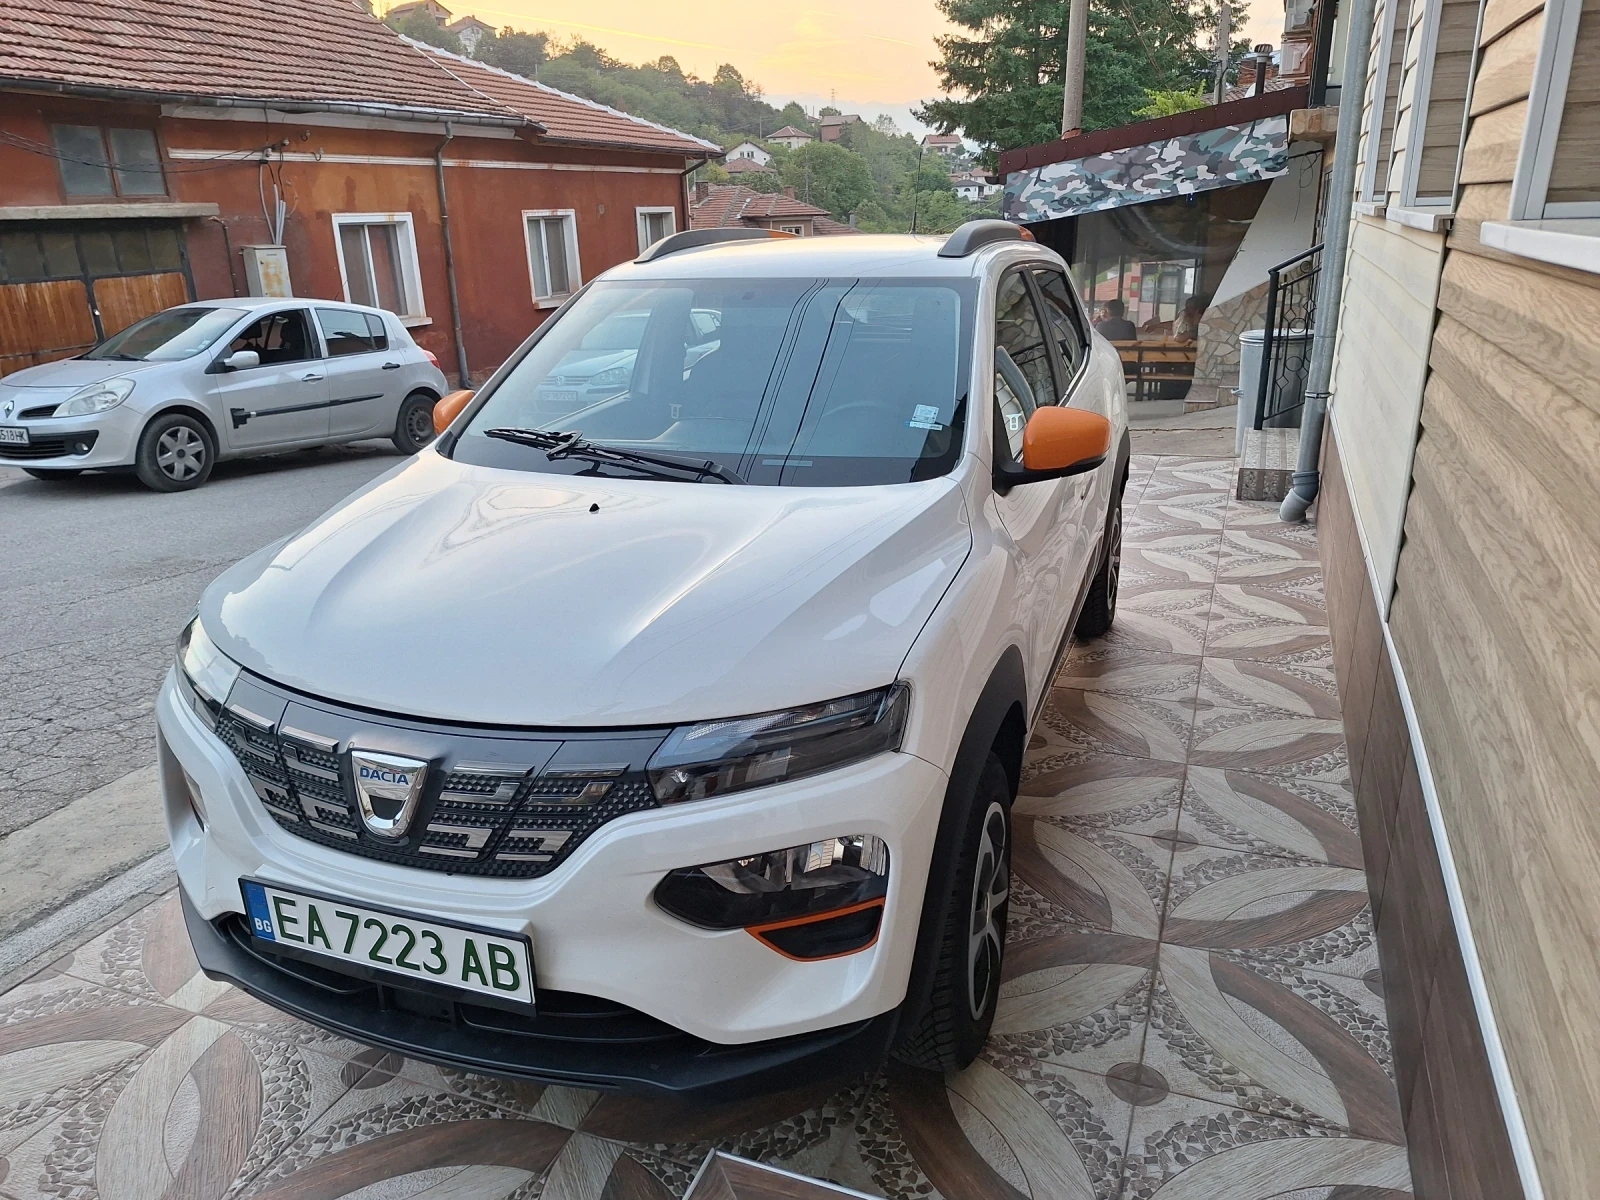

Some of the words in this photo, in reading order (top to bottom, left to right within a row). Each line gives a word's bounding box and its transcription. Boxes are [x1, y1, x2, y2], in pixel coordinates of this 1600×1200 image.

[0, 430, 14, 440] 518
[359, 766, 409, 785] DACIA
[254, 917, 272, 933] BG
[272, 895, 332, 950] EA
[335, 910, 448, 976] 7223
[461, 938, 521, 992] AB
